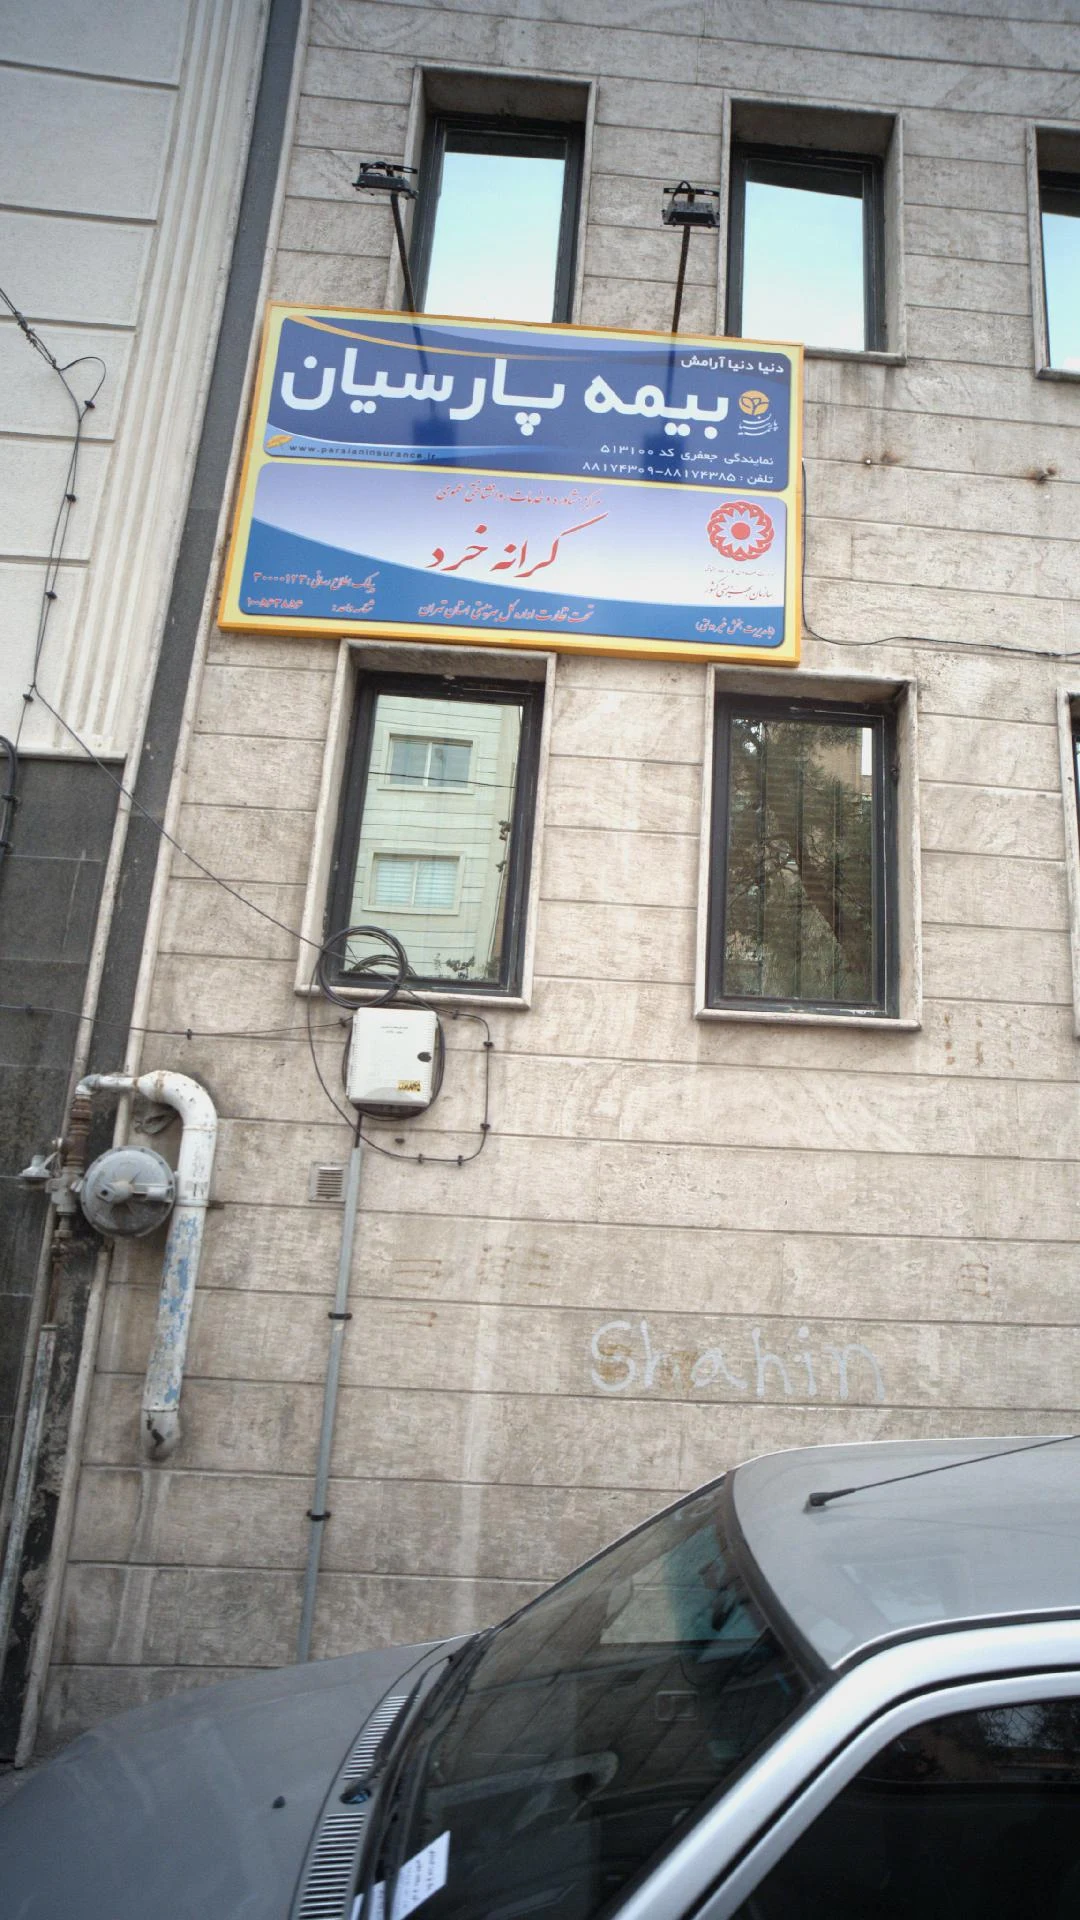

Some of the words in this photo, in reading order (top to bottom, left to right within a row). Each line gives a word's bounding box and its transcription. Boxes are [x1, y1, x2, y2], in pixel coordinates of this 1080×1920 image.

[680, 355, 726, 370] آرامش
[728, 359, 755, 372] دنیا
[758, 361, 784, 375] دنیا
[281, 347, 565, 436] پارسیان
[583, 375, 729, 440] بیمه
[600, 444, 654, 455] ۵۱۳۱۰۰
[659, 449, 675, 458] کد
[681, 450, 719, 463] جعفری
[724, 452, 774, 466] نمایندگی
[747, 474, 774, 485] تلفن
[425, 524, 489, 571] خرد
[489, 512, 608, 578] کرانه
[591, 1319, 886, 1401] Shahin
